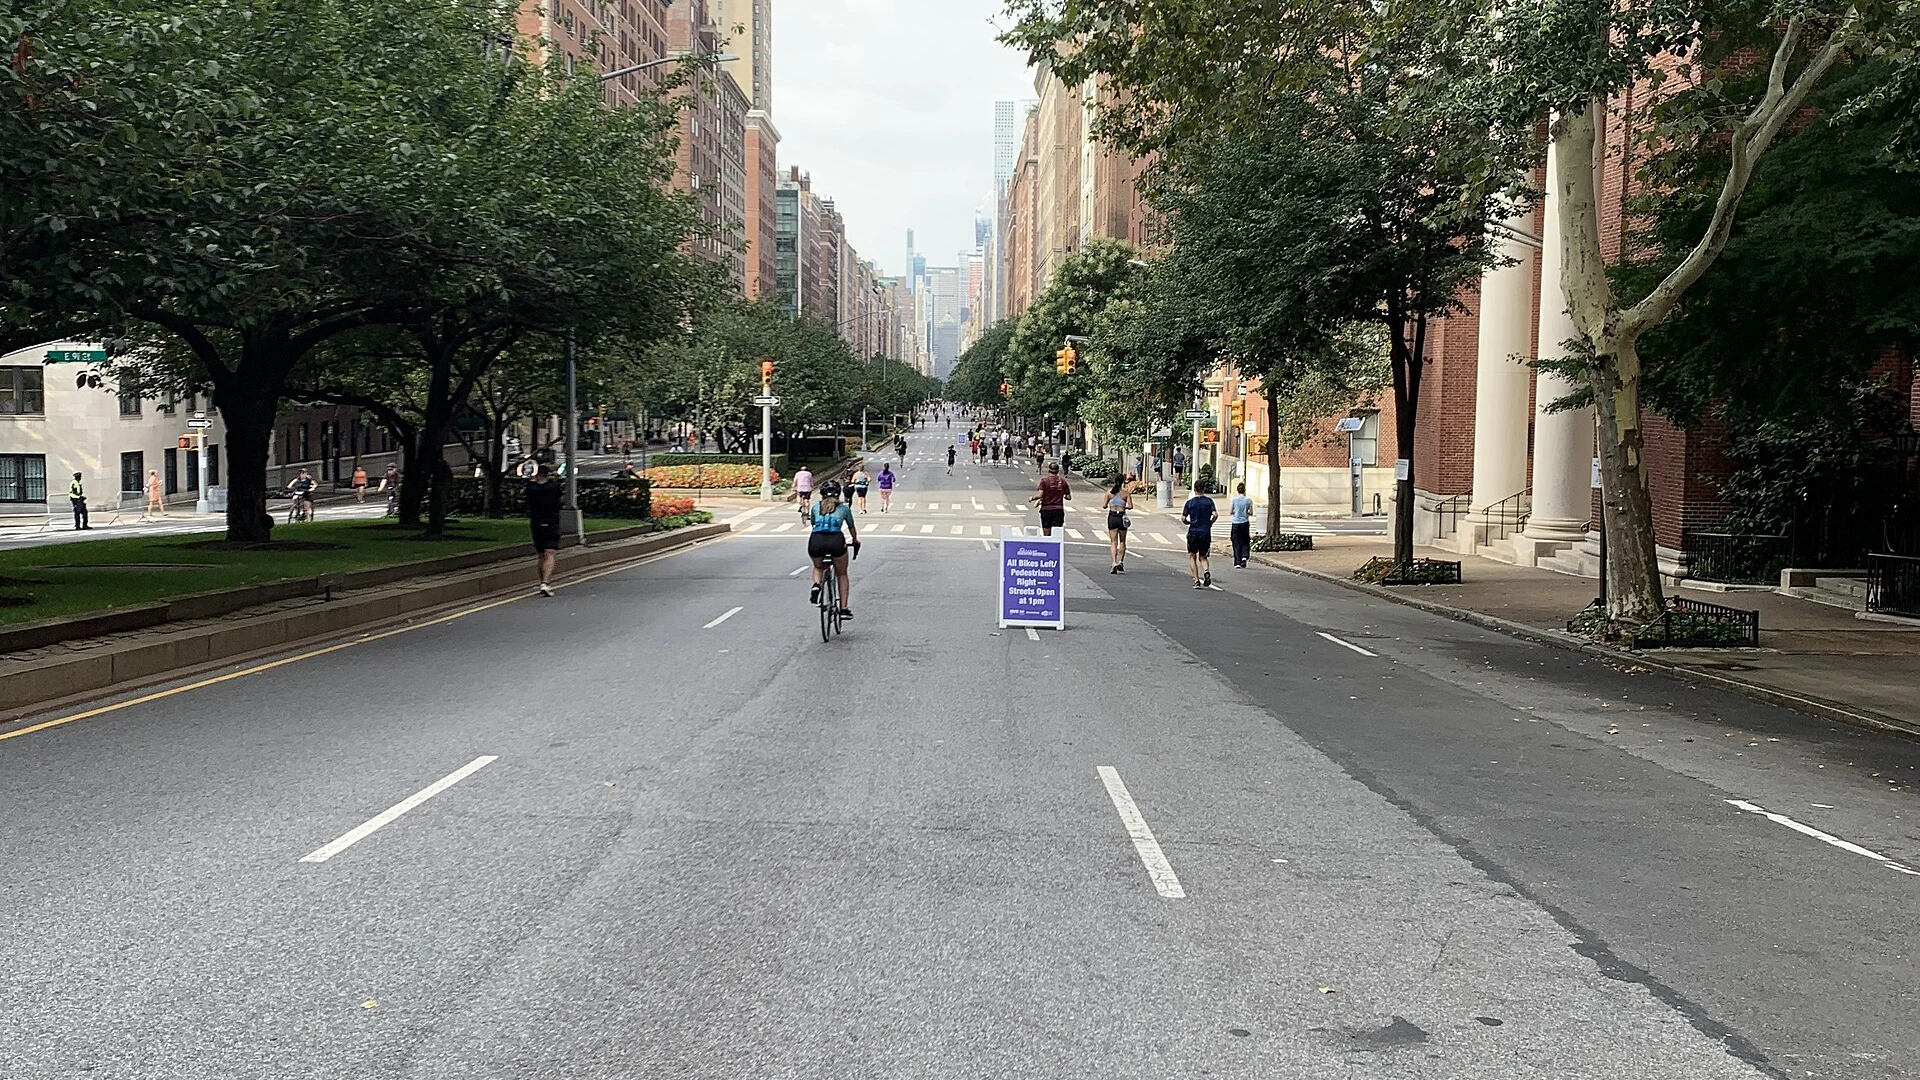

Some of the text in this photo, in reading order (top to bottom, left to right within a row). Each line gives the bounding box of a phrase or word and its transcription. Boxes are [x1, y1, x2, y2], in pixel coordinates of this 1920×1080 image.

[64, 352, 70, 360] E
[1018, 560, 1038, 568] Bikes
[1010, 569, 1054, 577] Pedestrians
[1016, 578, 1036, 586] Right
[1008, 587, 1055, 596] Streets Open
[1028, 597, 1045, 606] 1pm
